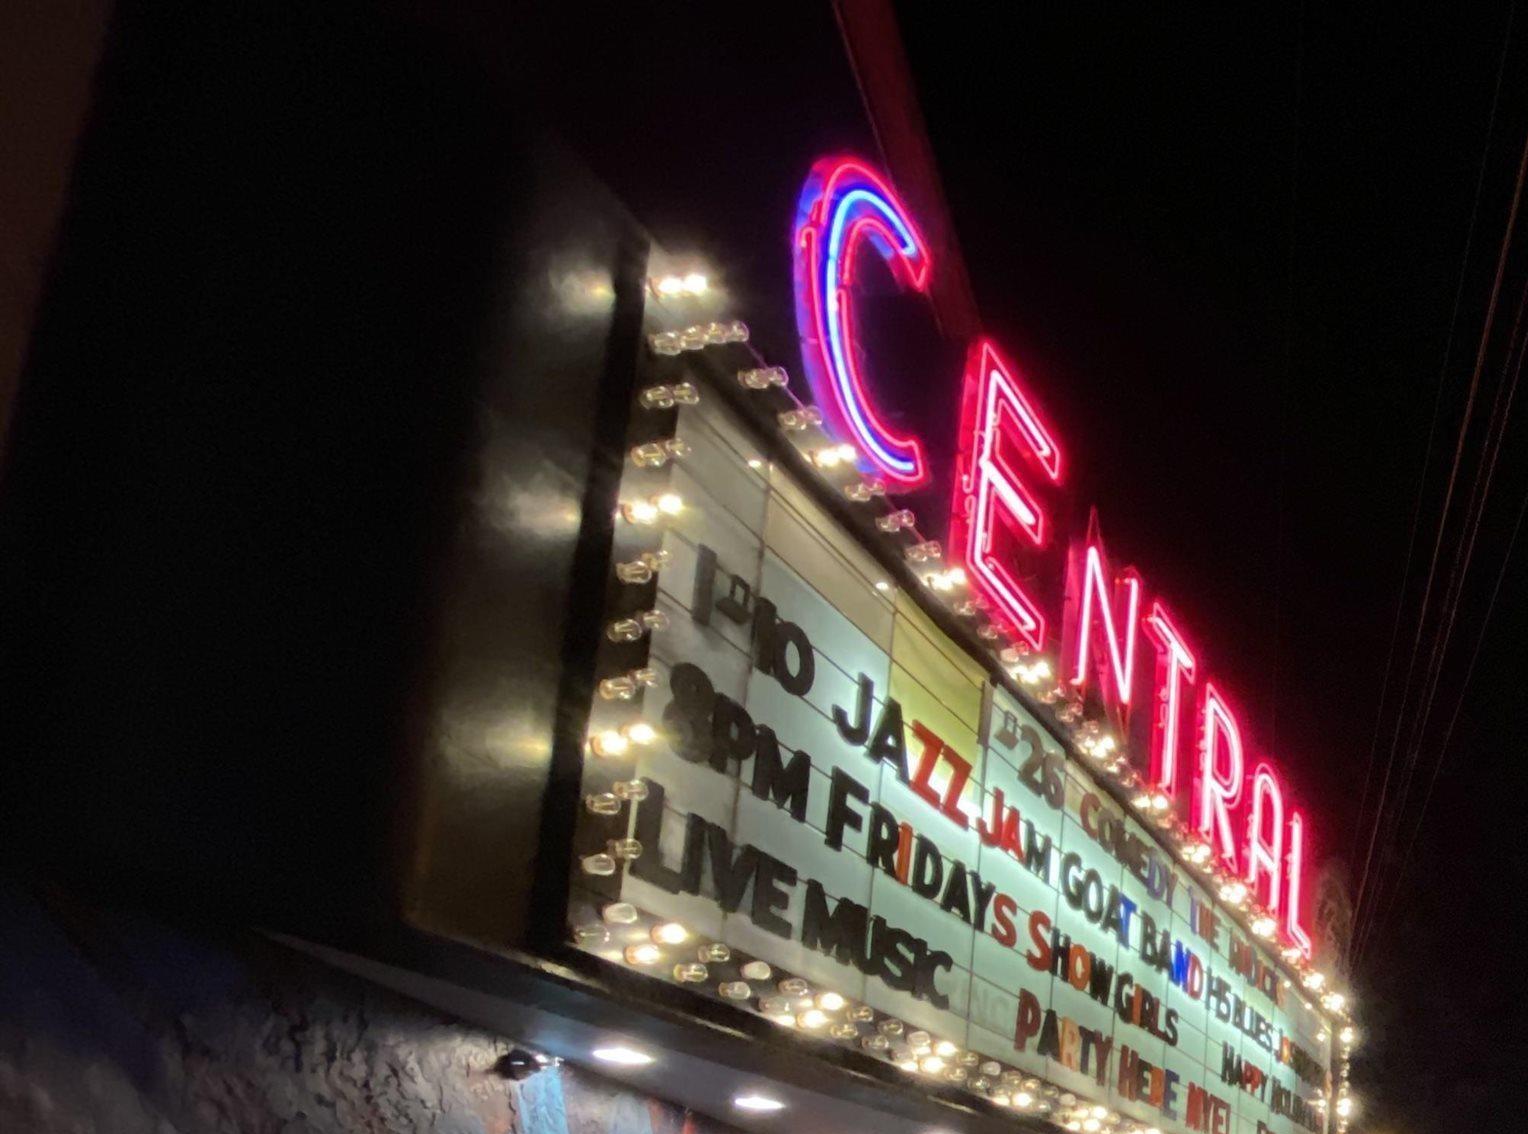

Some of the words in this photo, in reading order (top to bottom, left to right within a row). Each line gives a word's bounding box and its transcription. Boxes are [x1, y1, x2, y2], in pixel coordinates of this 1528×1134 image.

[794, 153, 1313, 965] CENTRAL
[628, 776, 798, 940] LIVE
[801, 878, 954, 1010] MUSIC
[1013, 987, 1114, 1087] PARTY
[1117, 1044, 1181, 1121] HERE
[662, 661, 812, 824] 8PM
[825, 766, 1018, 948] FRIDAYS
[1221, 1040, 1269, 1103] HAPPY
[831, 671, 973, 831] JAZZ
[976, 786, 1052, 885] JAM
[1060, 851, 1138, 949] GOAT
[1140, 911, 1203, 1000] BAND
[1080, 793, 1179, 910] COMEDY
